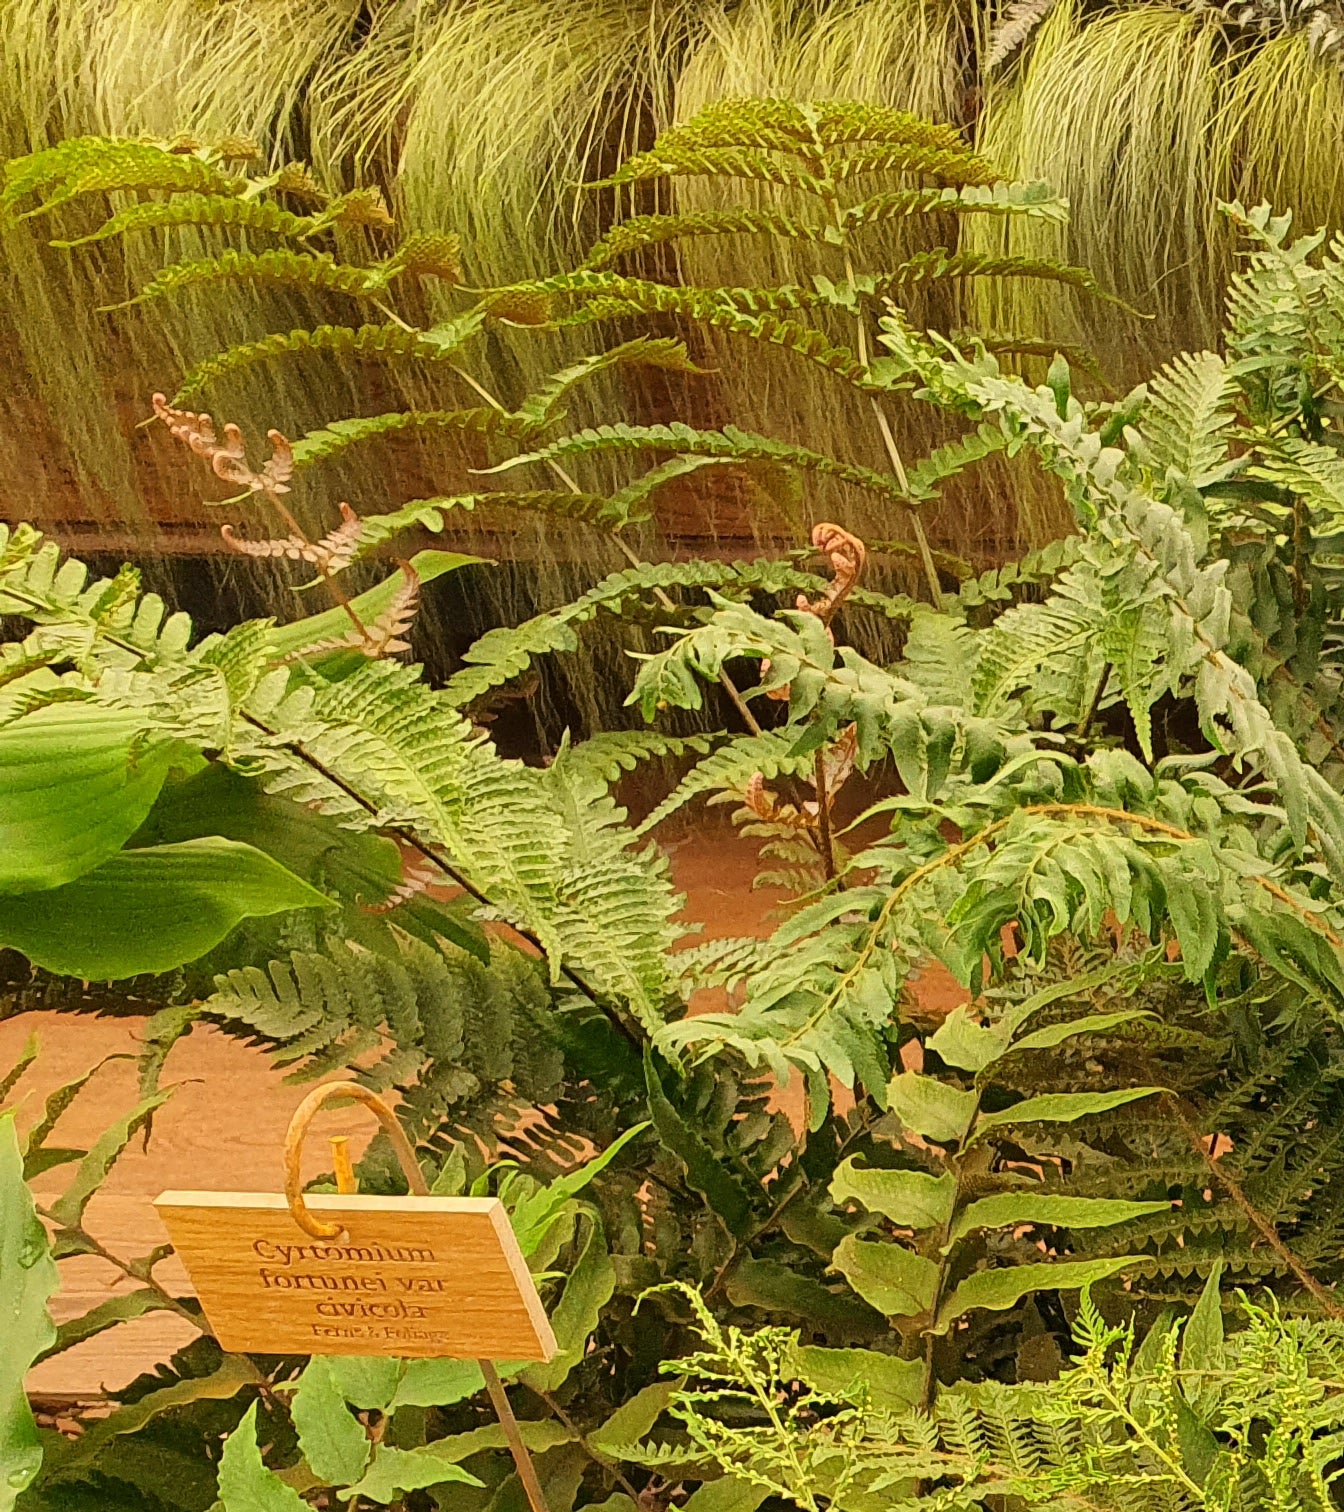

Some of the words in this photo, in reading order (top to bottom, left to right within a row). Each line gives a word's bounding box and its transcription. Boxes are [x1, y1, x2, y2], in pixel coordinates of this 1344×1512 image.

[252, 1239, 436, 1266] Cyrtomium
[259, 1268, 388, 1292] fortunei
[396, 1278, 447, 1292] var
